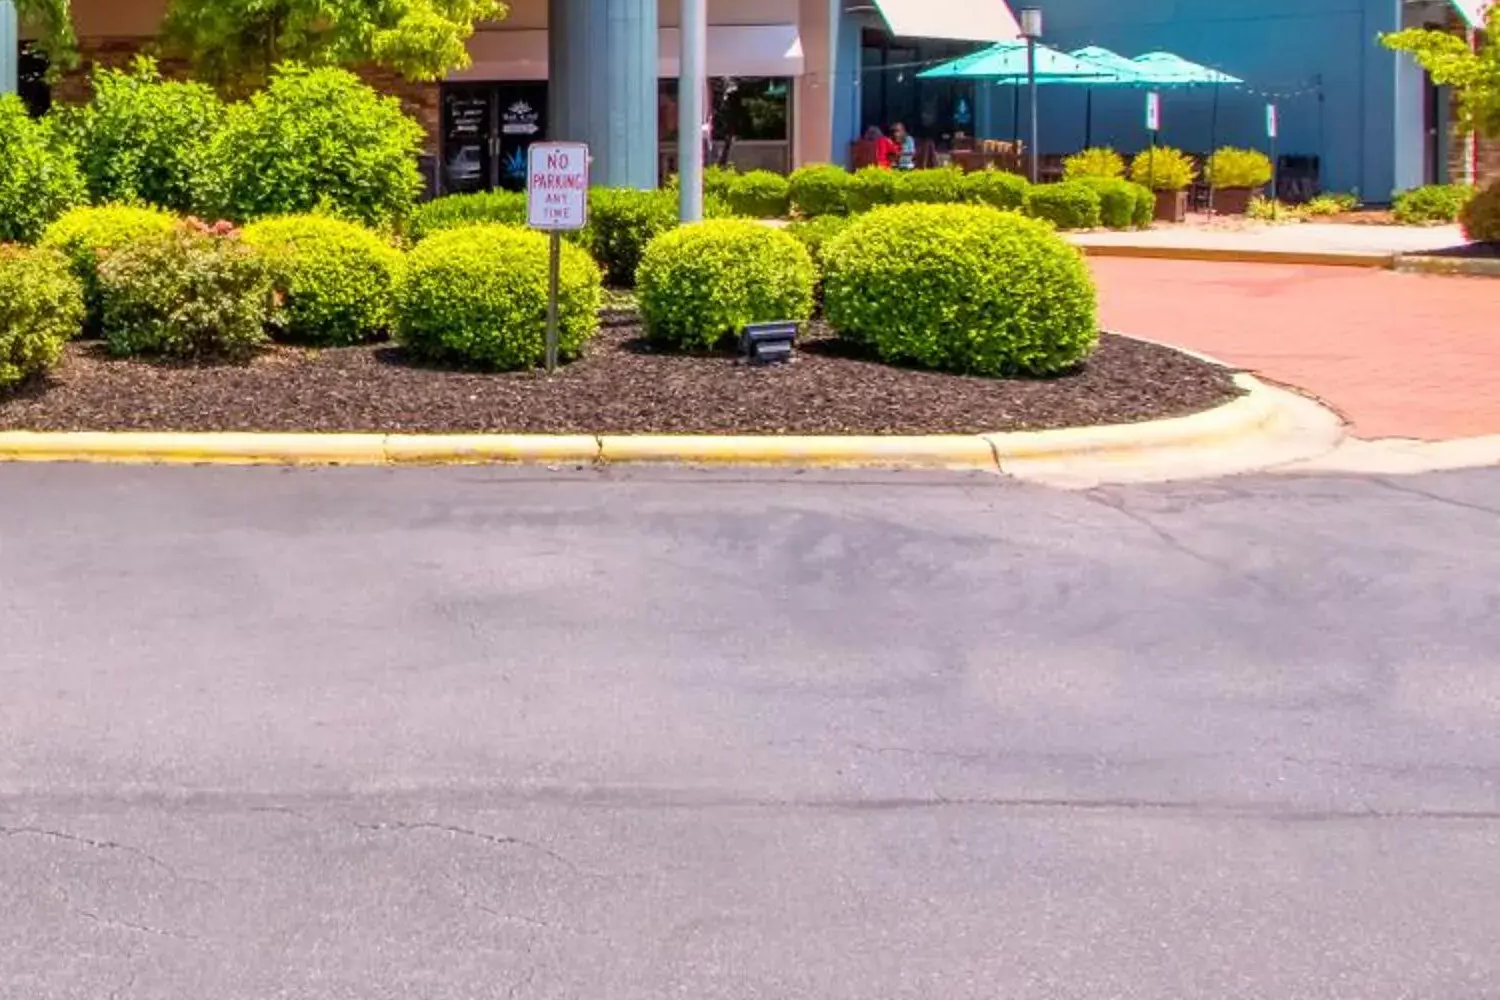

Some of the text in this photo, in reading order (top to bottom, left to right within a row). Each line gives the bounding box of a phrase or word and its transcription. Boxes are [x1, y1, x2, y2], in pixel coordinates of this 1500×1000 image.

[547, 153, 568, 169] NO
[533, 173, 584, 190] PARKING
[546, 193, 567, 203] ANY
[544, 207, 571, 218] TIME
